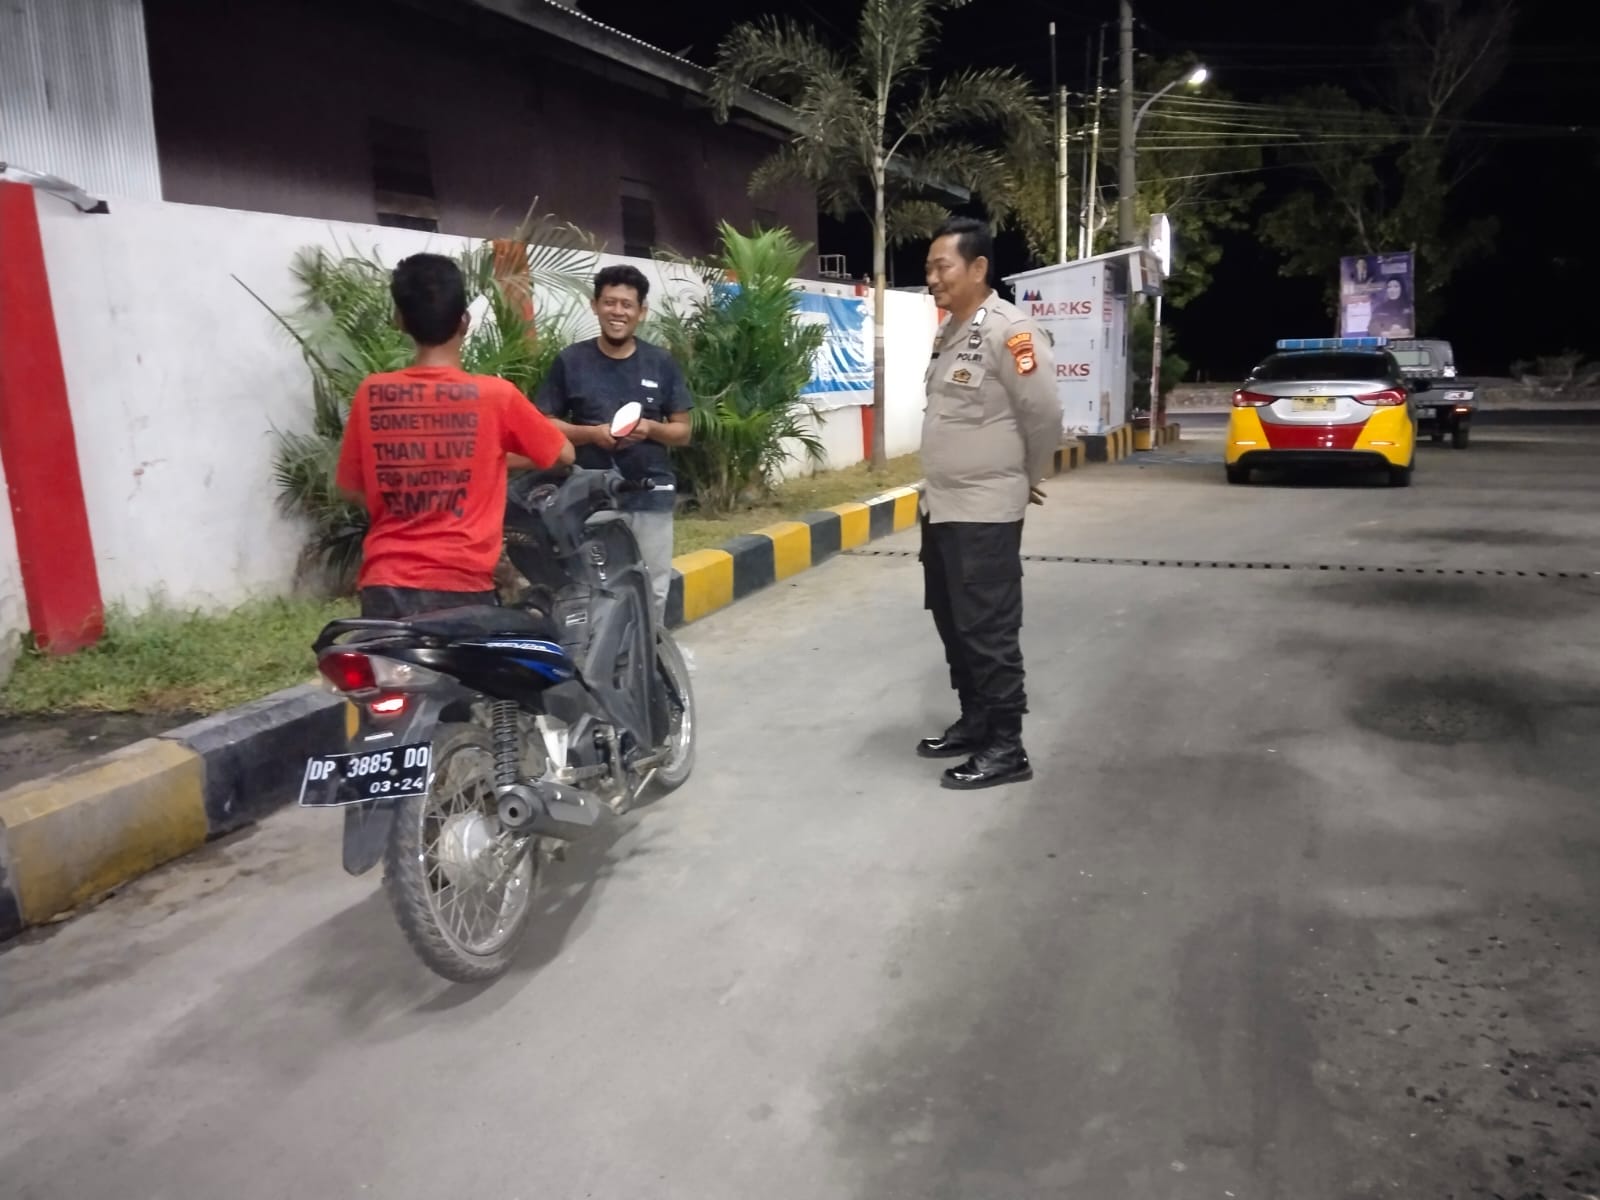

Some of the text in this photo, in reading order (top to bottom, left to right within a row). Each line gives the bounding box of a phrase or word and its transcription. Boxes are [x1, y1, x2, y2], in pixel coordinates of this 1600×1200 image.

[1031, 300, 1092, 316] MARKS
[1056, 363, 1090, 377] RKS
[368, 383, 480, 402] FIGHT FOR
[370, 412, 478, 431] SOMETHING
[373, 440, 476, 461] THAN LIVE
[406, 468, 472, 487] NOTHING
[309, 760, 336, 780] DP
[347, 752, 394, 777] 3885
